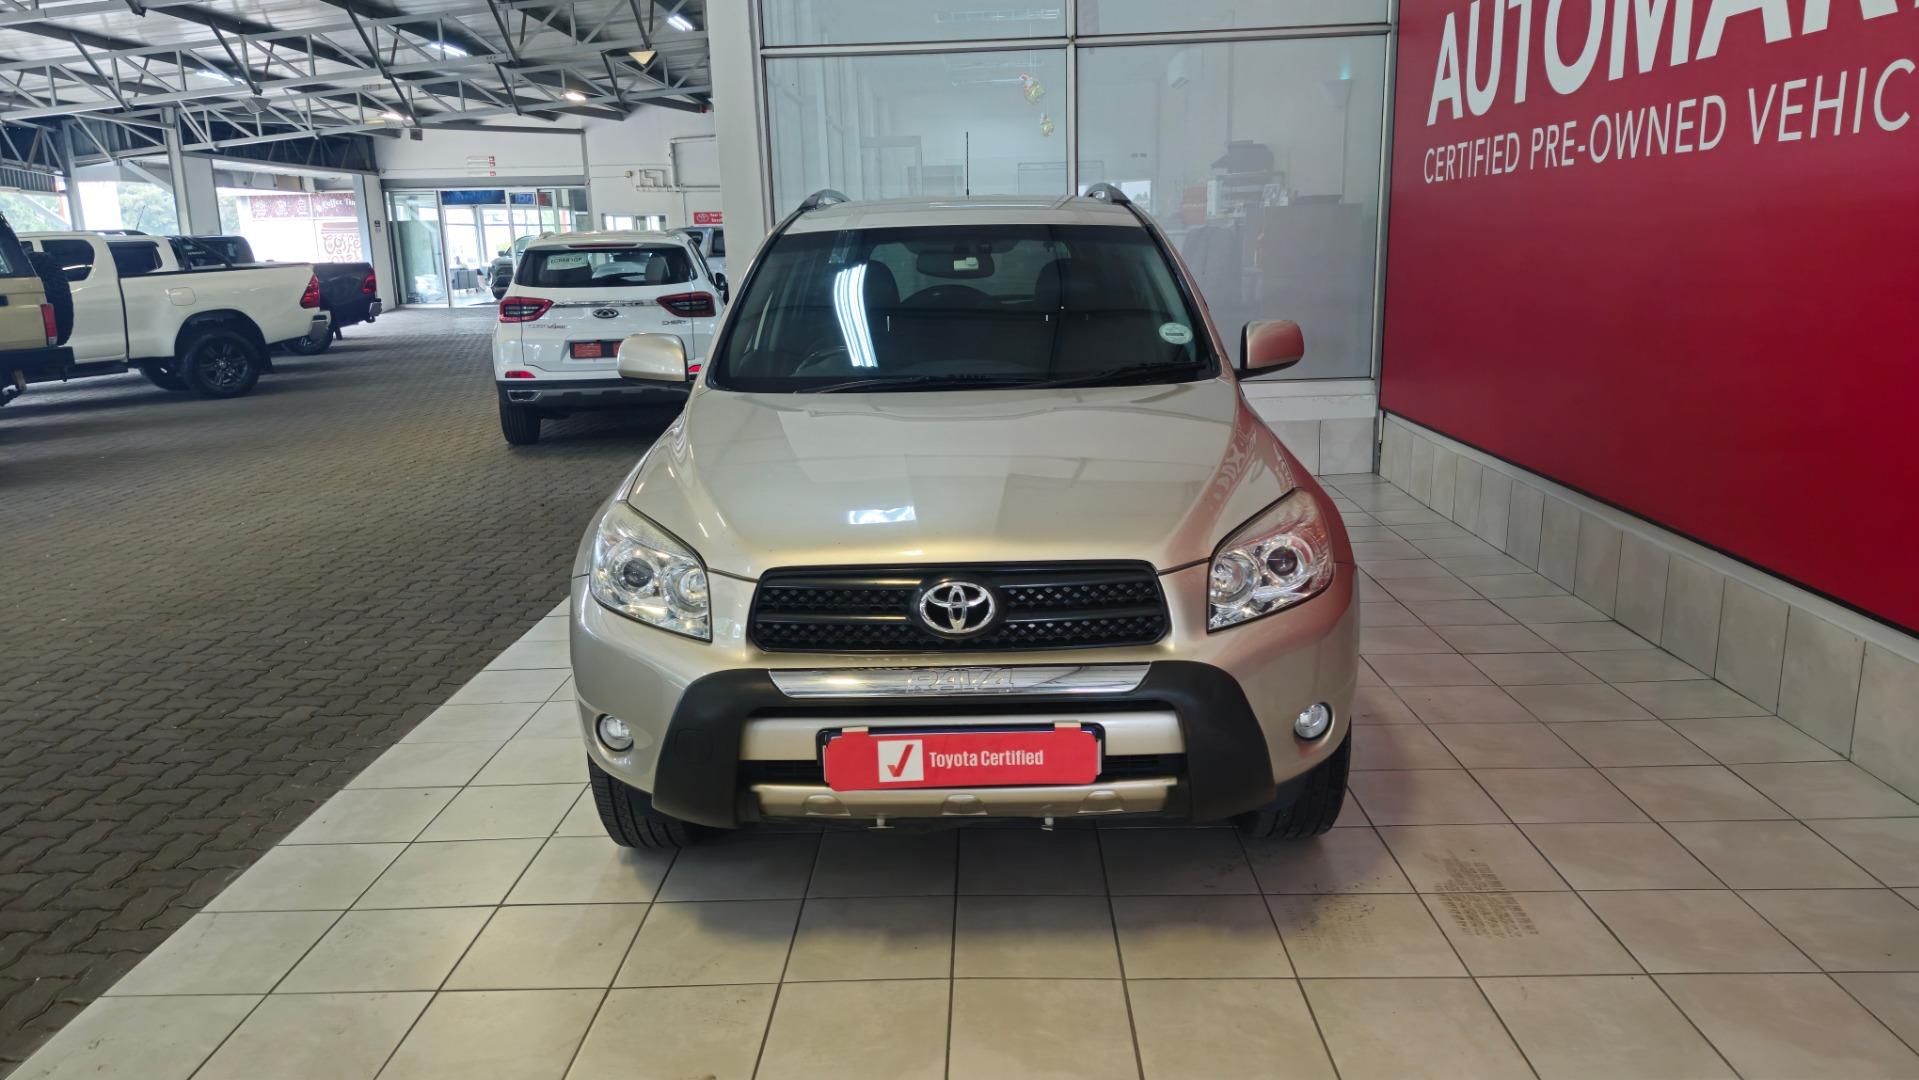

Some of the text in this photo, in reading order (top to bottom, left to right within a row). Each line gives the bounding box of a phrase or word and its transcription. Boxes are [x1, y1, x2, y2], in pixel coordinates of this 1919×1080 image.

[1426, 0, 1919, 127] AUTOM
[1423, 58, 1917, 184] CERTIFIED PRE-OWNED VEHIC
[906, 667, 1015, 692] RAV4
[929, 750, 1044, 769] Toyota Certified
